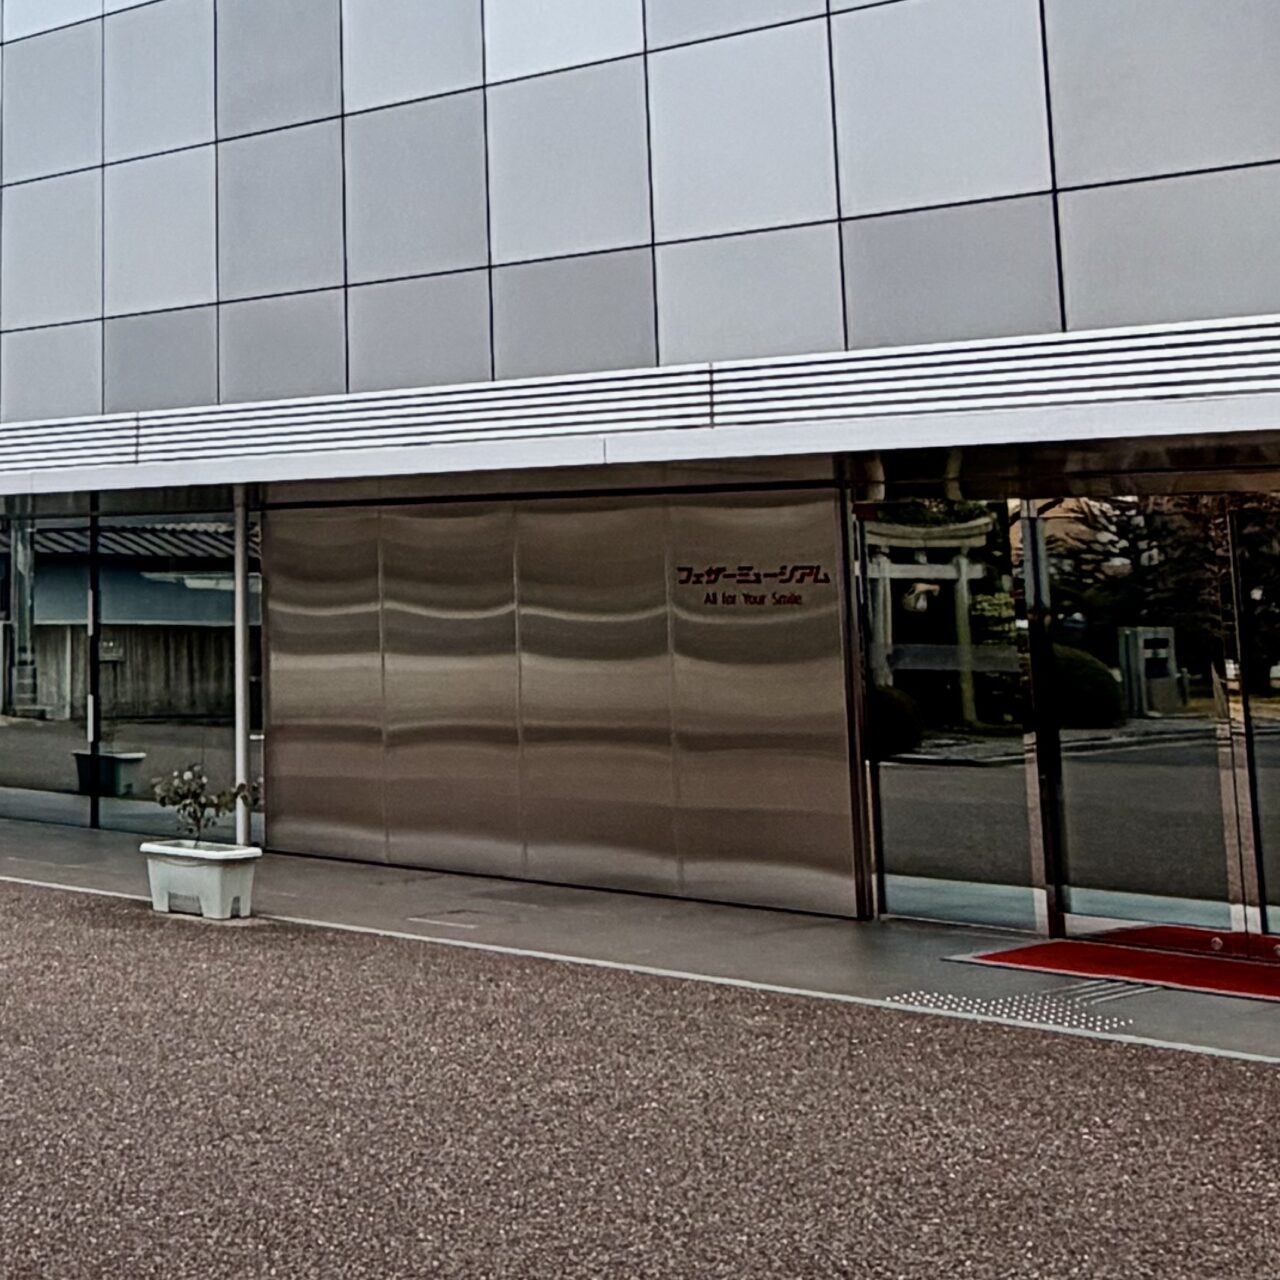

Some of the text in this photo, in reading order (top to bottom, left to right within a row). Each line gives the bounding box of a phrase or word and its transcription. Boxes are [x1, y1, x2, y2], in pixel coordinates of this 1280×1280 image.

[677, 565, 830, 584] フェザーミュージアム
[704, 591, 803, 606] All for Your Smile
